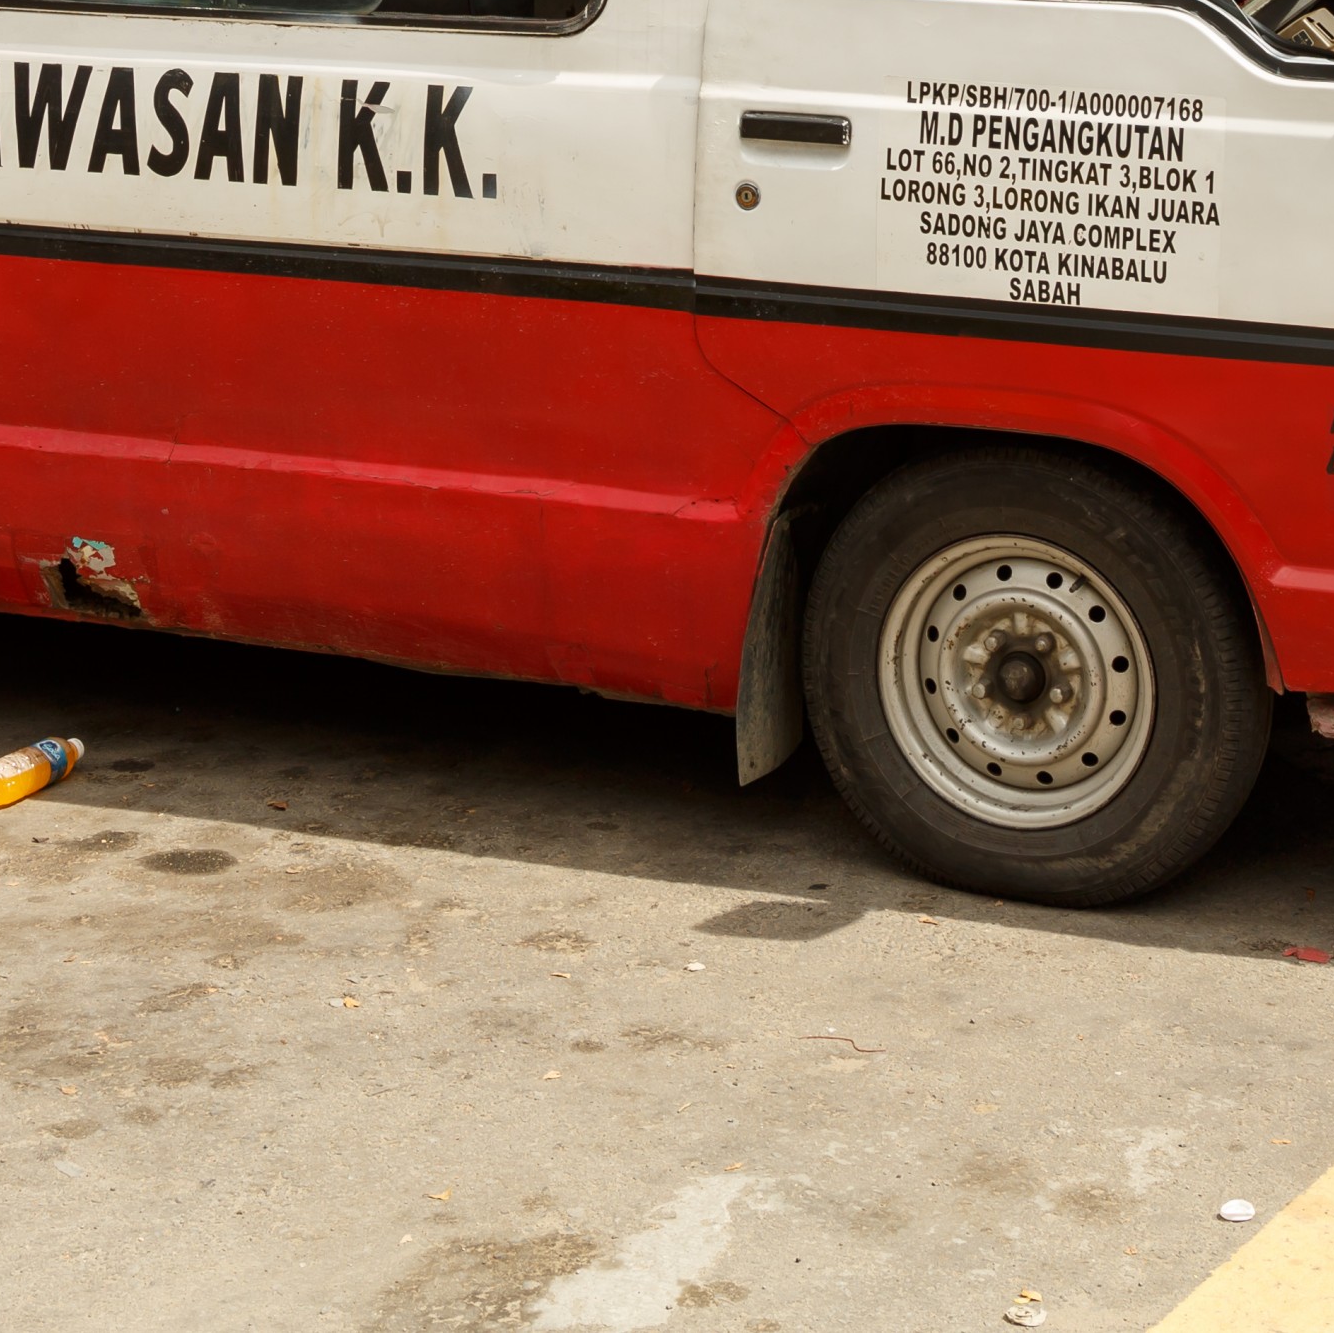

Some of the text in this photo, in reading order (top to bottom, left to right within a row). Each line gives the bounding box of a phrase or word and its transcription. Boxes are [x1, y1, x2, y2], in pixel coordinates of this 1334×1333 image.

[906, 80, 1204, 122] LPKP/SBH/700-1/A000007168
[338, 78, 498, 199] K.K.
[919, 110, 1185, 162] M.D PENGANGKUTAN
[886, 147, 1215, 194] LOT 66,NO 2,TINGKAT 3,BLOK 1
[880, 177, 1221, 226] LORONG 3,LORONG IKAN JUARA
[919, 211, 1177, 254] SADONG JAYA COMPLEX
[926, 242, 1168, 284] 88100 KOTA KINABALU
[1009, 277, 1081, 306] SABAH
